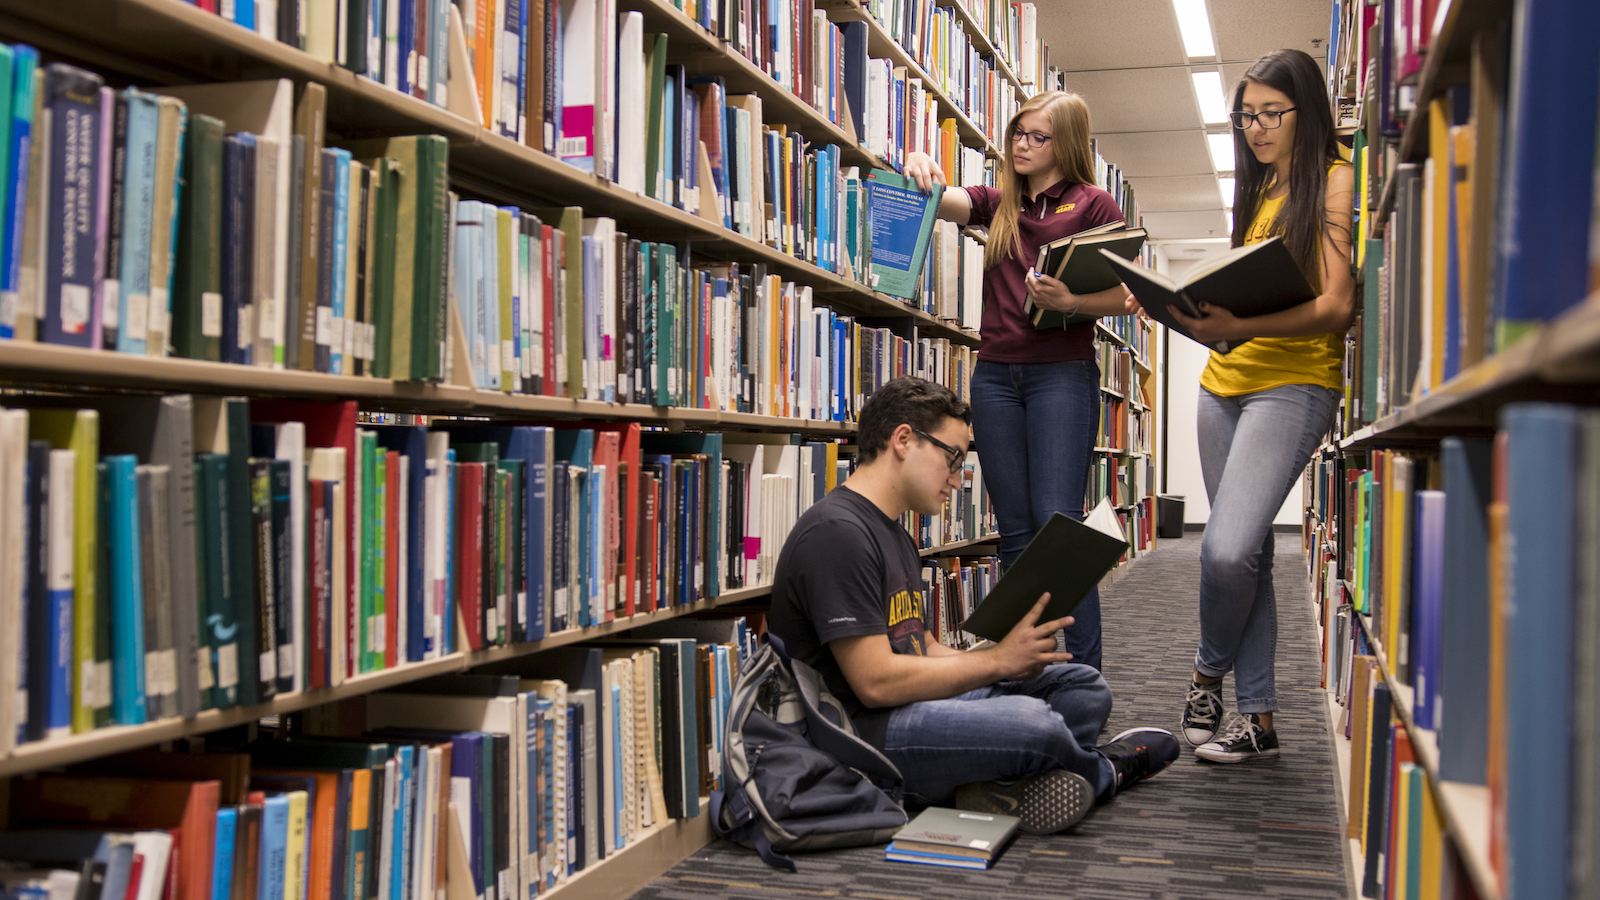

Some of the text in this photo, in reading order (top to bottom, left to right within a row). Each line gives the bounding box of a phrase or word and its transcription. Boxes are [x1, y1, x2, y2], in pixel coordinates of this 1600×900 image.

[545, 43, 553, 112] GROUNDWATER
[65, 109, 80, 184] CONTROL
[76, 114, 94, 236] WATER QUALITY
[62, 187, 78, 278] HANDBOOK
